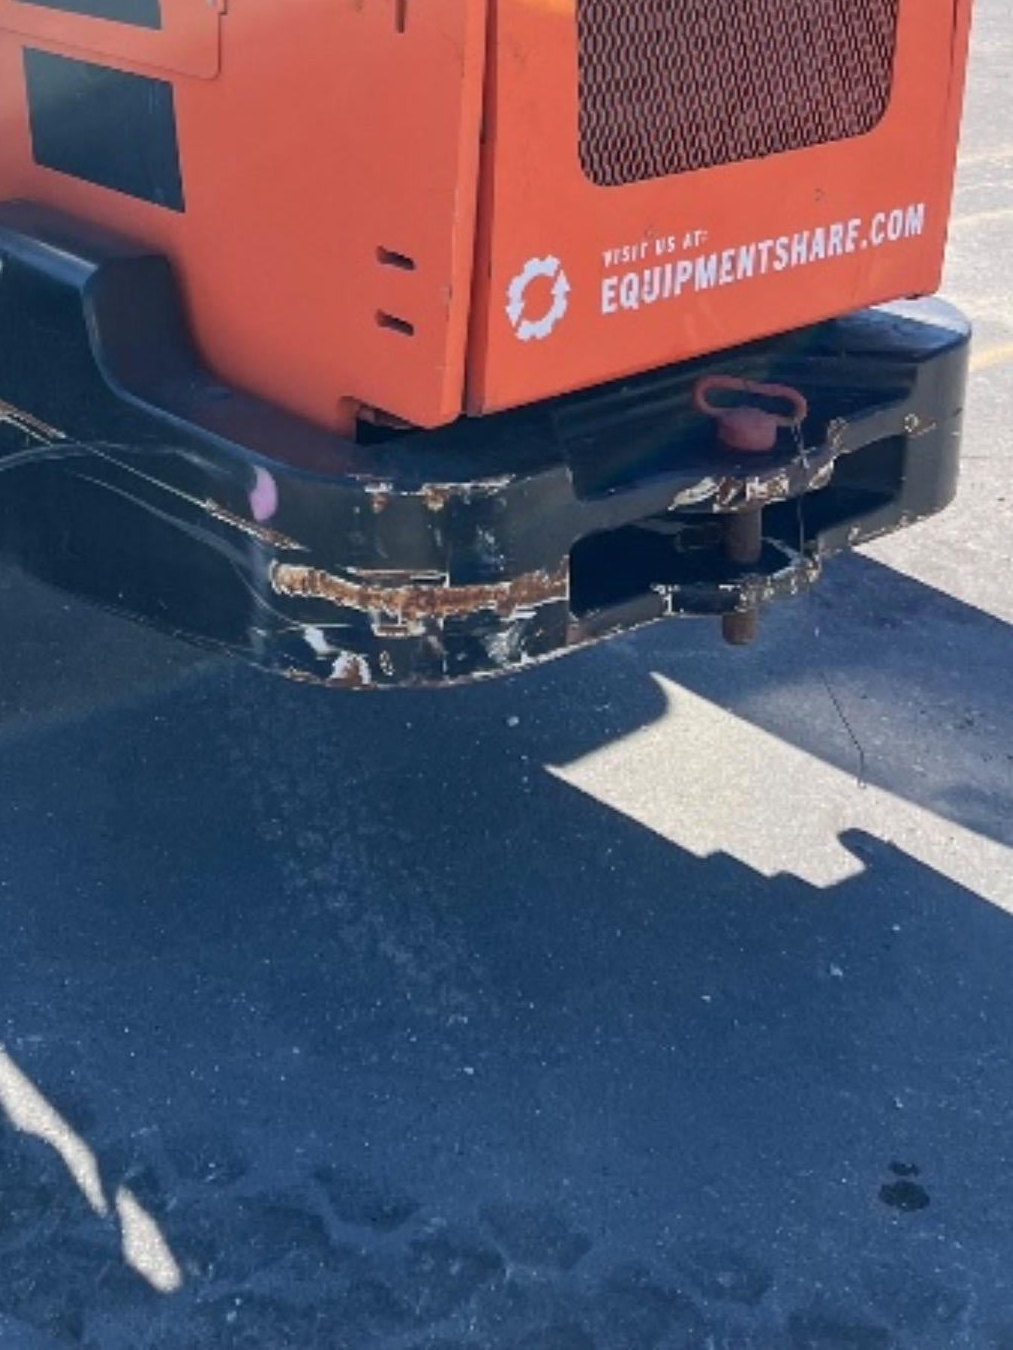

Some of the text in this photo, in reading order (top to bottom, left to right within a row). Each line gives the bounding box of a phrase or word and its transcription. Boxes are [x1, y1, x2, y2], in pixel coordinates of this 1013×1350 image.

[600, 202, 926, 315] EQUIPMENTSHARE.COM
[602, 242, 648, 268] VISIT
[655, 235, 676, 257] US
